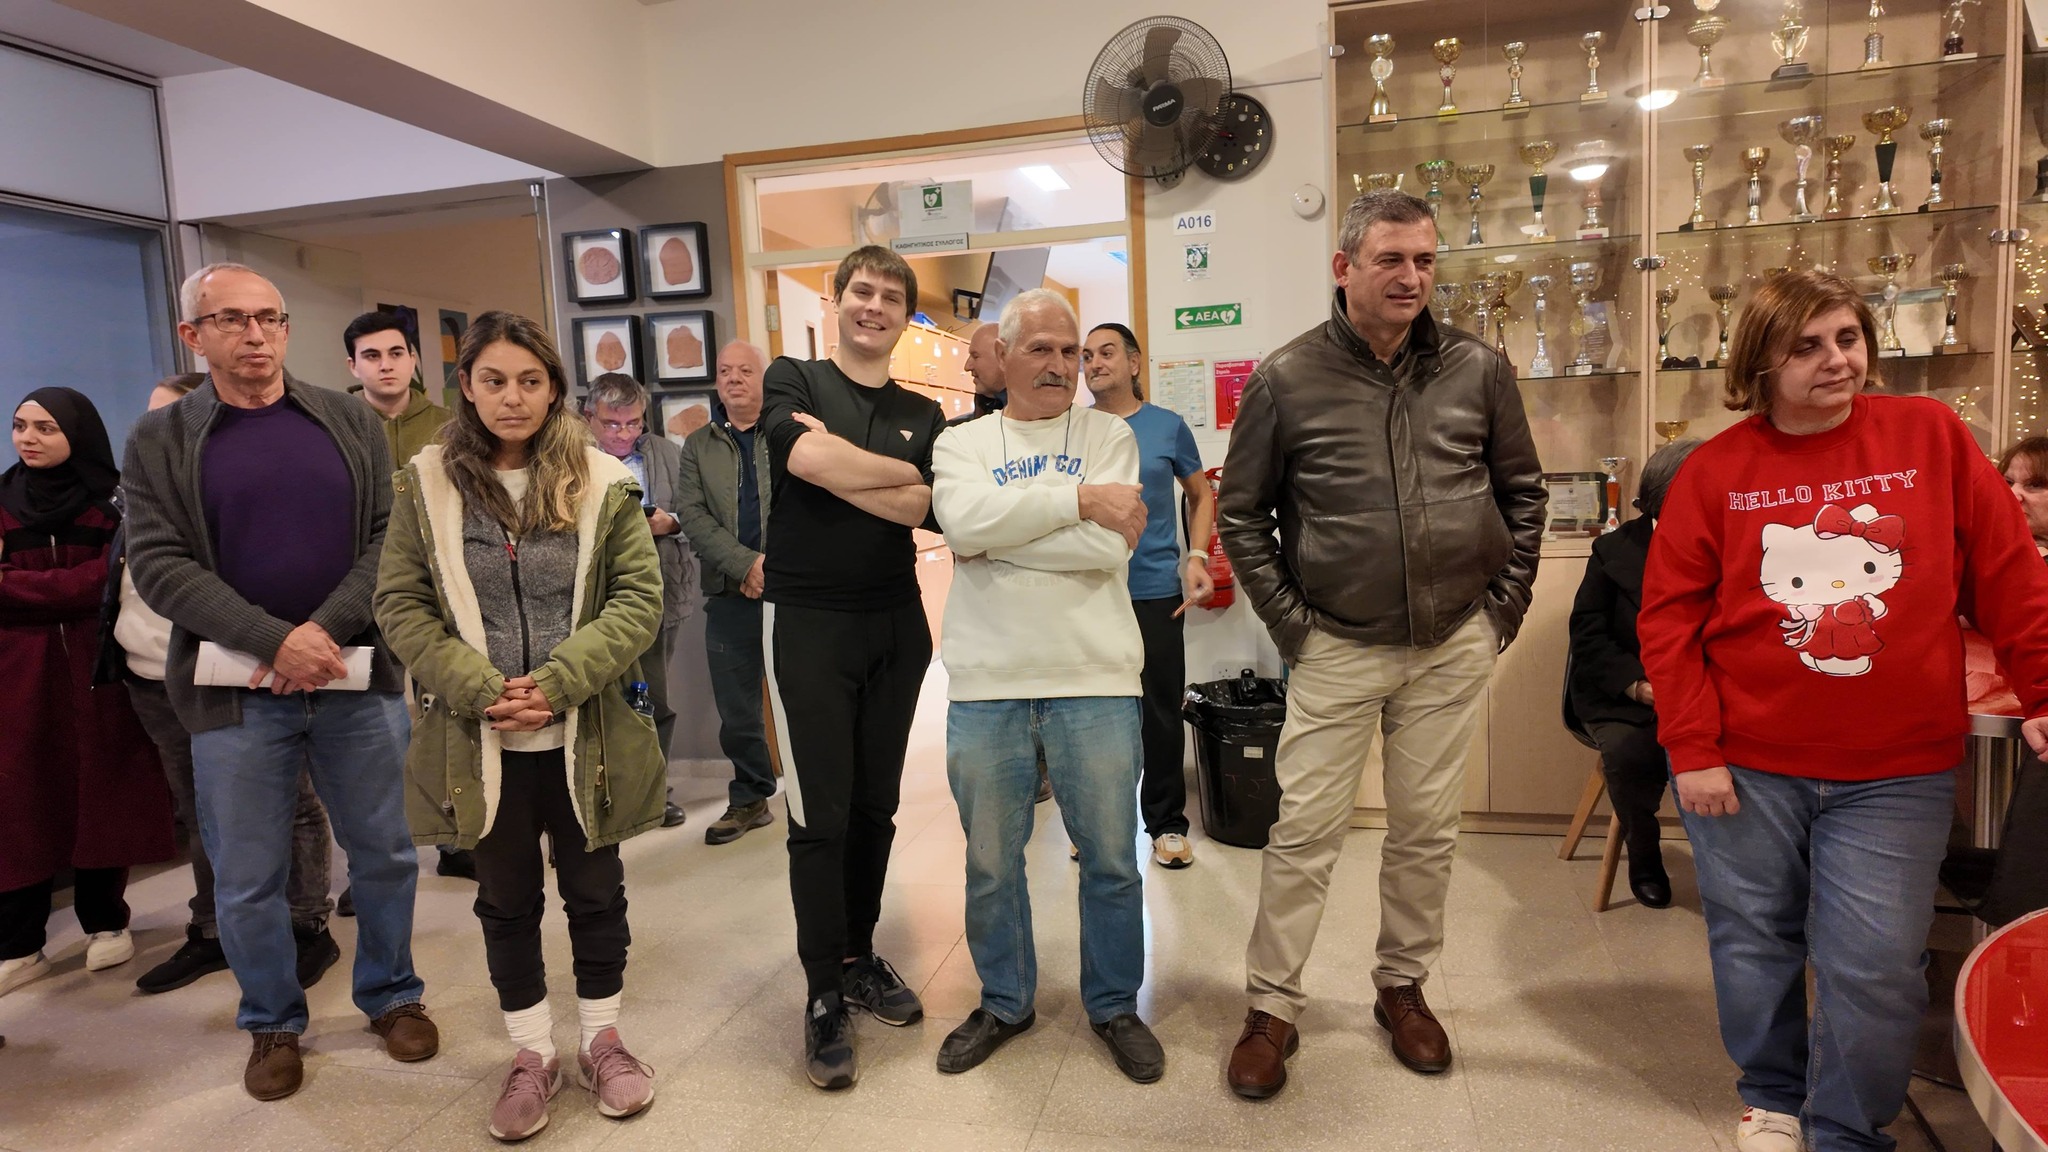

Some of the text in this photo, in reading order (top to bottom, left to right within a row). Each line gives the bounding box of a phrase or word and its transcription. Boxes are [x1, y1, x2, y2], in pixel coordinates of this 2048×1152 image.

[1253, 114, 1260, 122] 2
[1254, 143, 1260, 151] 4
[1227, 163, 1234, 171] 6
[1177, 215, 1212, 230] A016
[992, 454, 1048, 487] DENIM
[1728, 468, 1918, 511] HELLO KITTY
